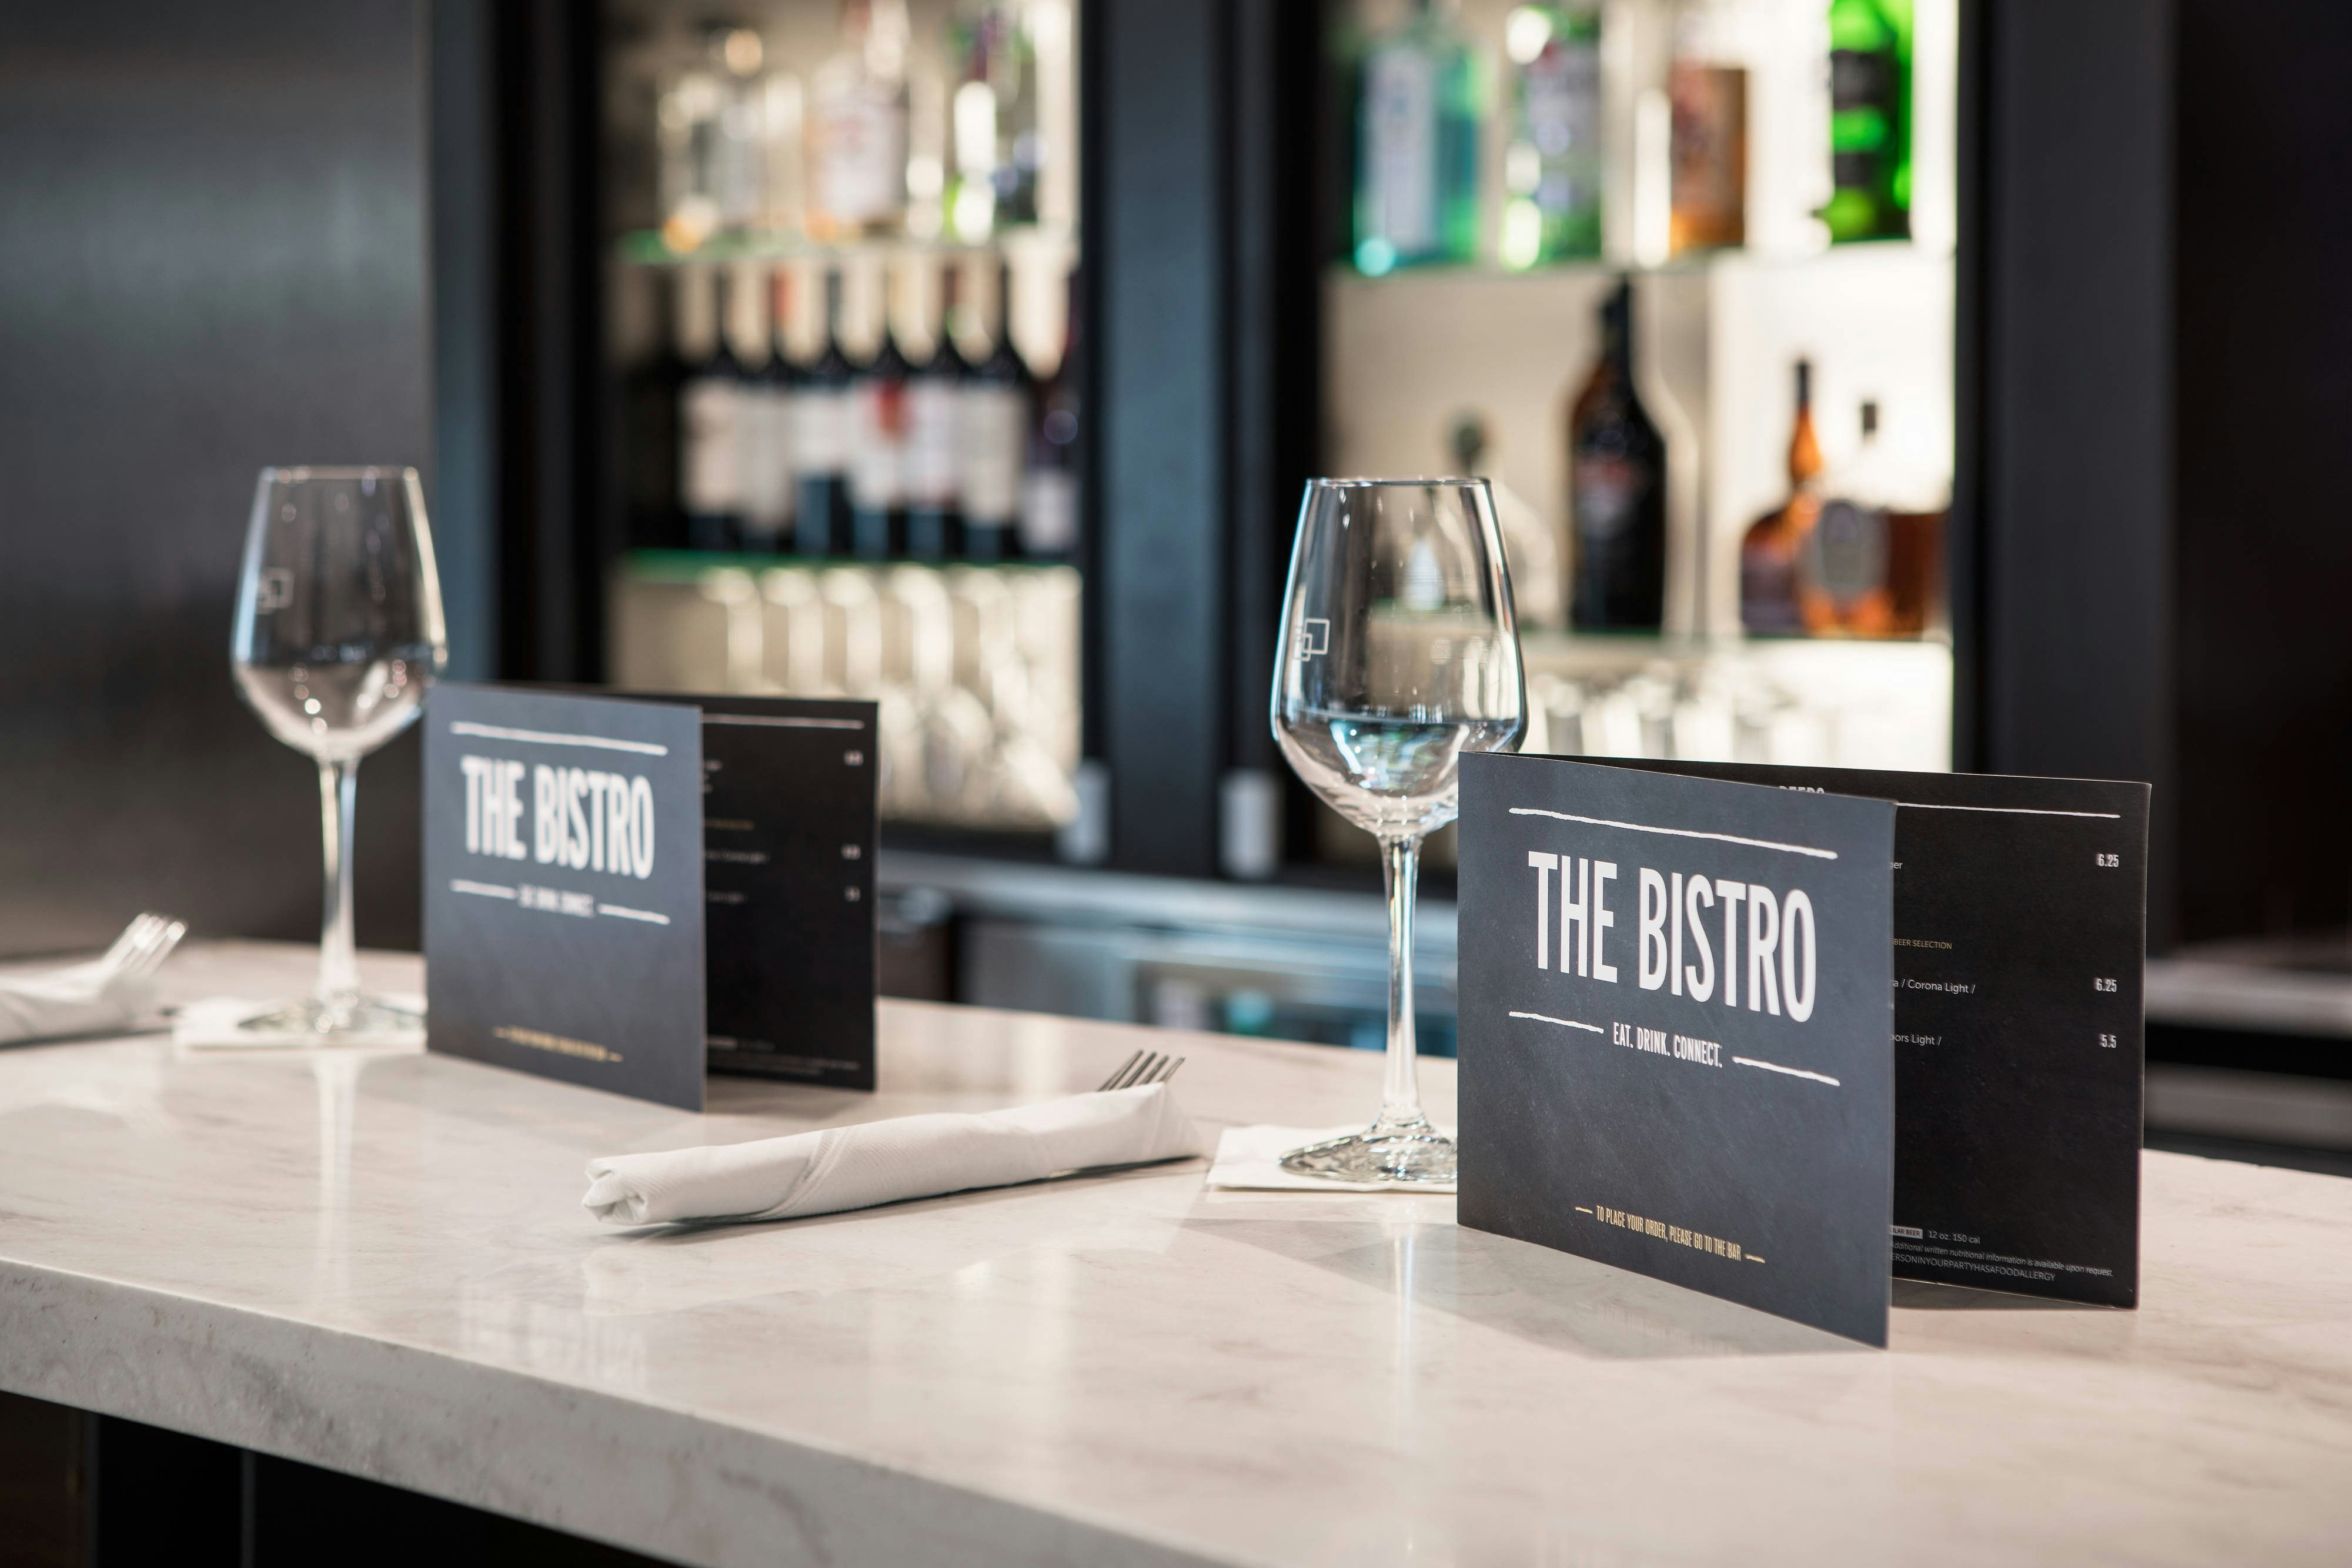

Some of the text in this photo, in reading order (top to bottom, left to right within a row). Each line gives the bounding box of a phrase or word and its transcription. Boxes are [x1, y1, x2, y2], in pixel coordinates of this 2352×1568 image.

[461, 755, 655, 880] THE BISTRO
[2096, 853, 2119, 868] 6.25
[1528, 851, 1816, 1023] THE BISTRO
[1893, 938, 1952, 950] BEER SELECTION
[1902, 979, 1906, 988] /
[1908, 979, 1943, 991] Corona
[1945, 982, 1969, 994] Light
[1971, 984, 1976, 994] /
[2094, 977, 2117, 992] 6.25
[1613, 1021, 1723, 1068] EAT. DRINK. CONNECT.
[1912, 1034, 1935, 1046] Light
[1937, 1037, 1942, 1046] /
[2099, 1034, 2117, 1048] 5.5
[1596, 1205, 1741, 1261] TO PLACE YOUR ORDER, PLEASE GO TO THE BAR
[1929, 1231, 1937, 1239] 12
[1953, 1234, 1967, 1242] 150
[1925, 1246, 1948, 1255] written
[1950, 1249, 1984, 1260] nutritional
[1986, 1253, 2026, 1265] information
[2034, 1259, 2065, 1271] available
[2066, 1265, 2084, 1273] upon
[2087, 1267, 2114, 1277] request.
